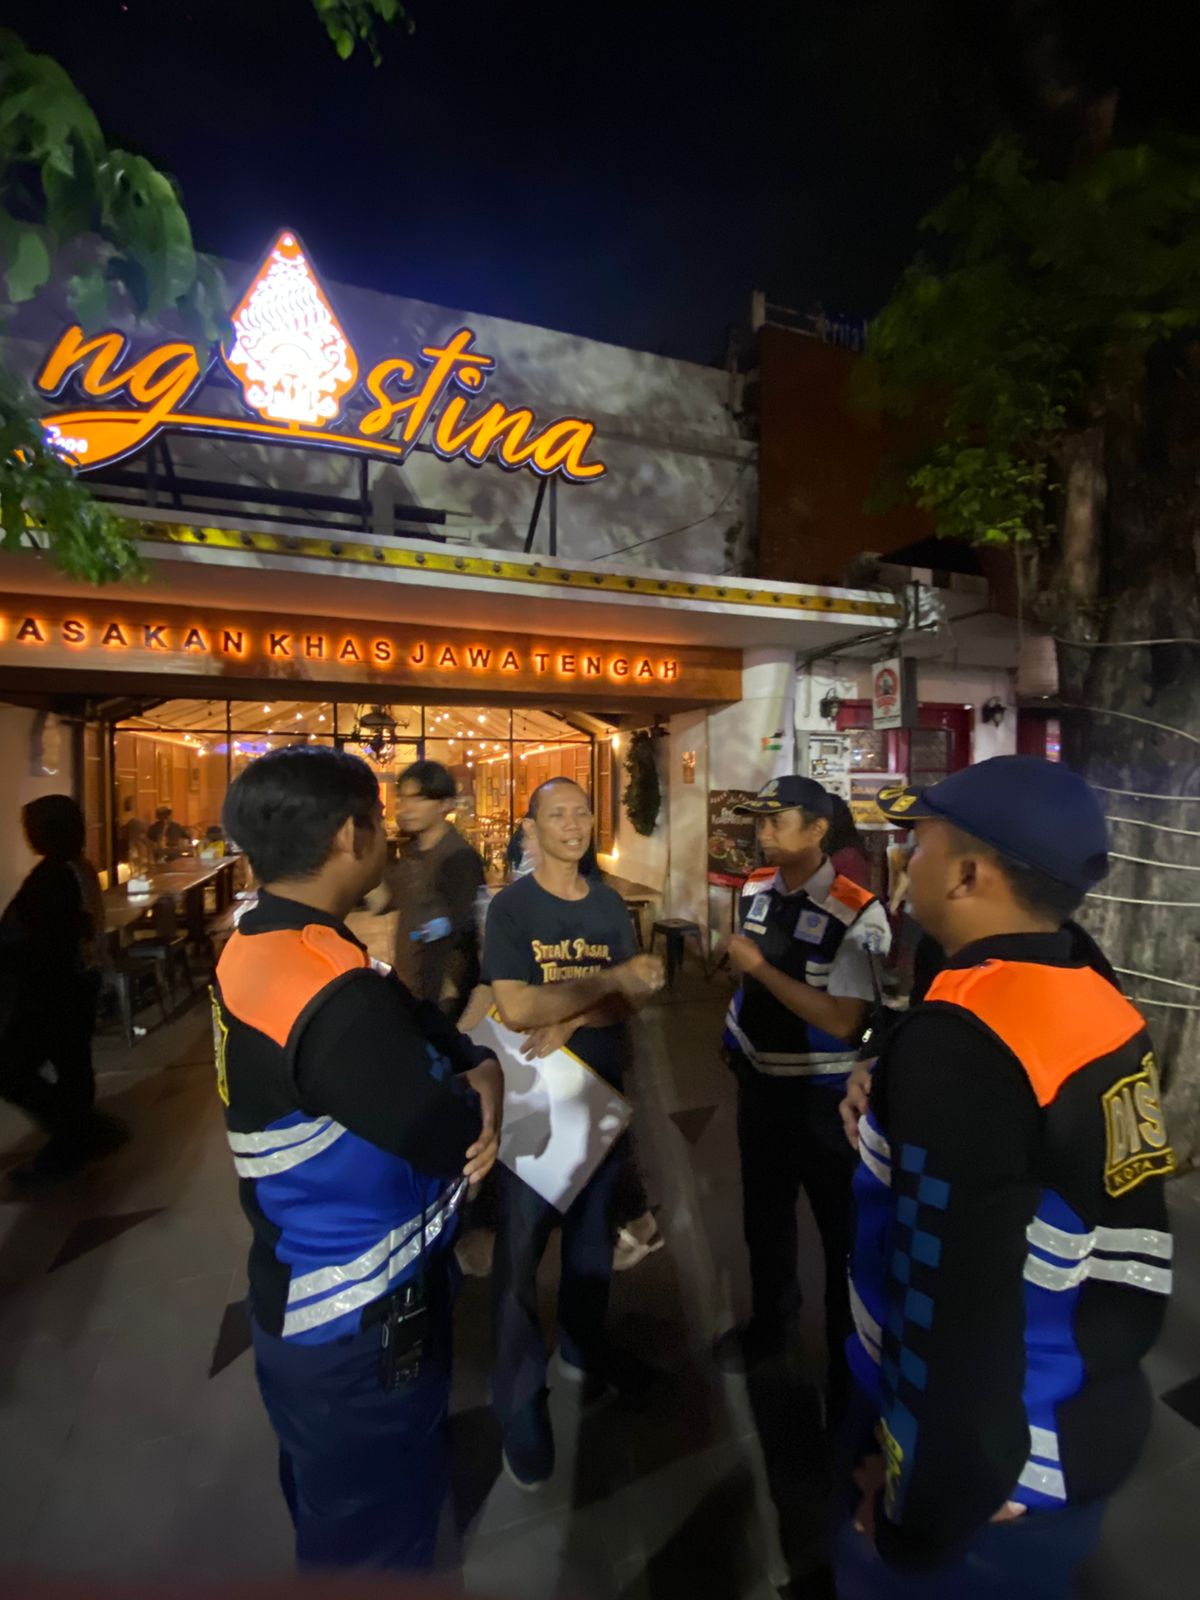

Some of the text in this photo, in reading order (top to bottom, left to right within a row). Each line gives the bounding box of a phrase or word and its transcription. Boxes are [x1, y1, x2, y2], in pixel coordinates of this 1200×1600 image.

[0, 616, 677, 679] ASAKAN KHAS JAWA TENGAH
[1113, 1160, 1153, 1186] KOTA
